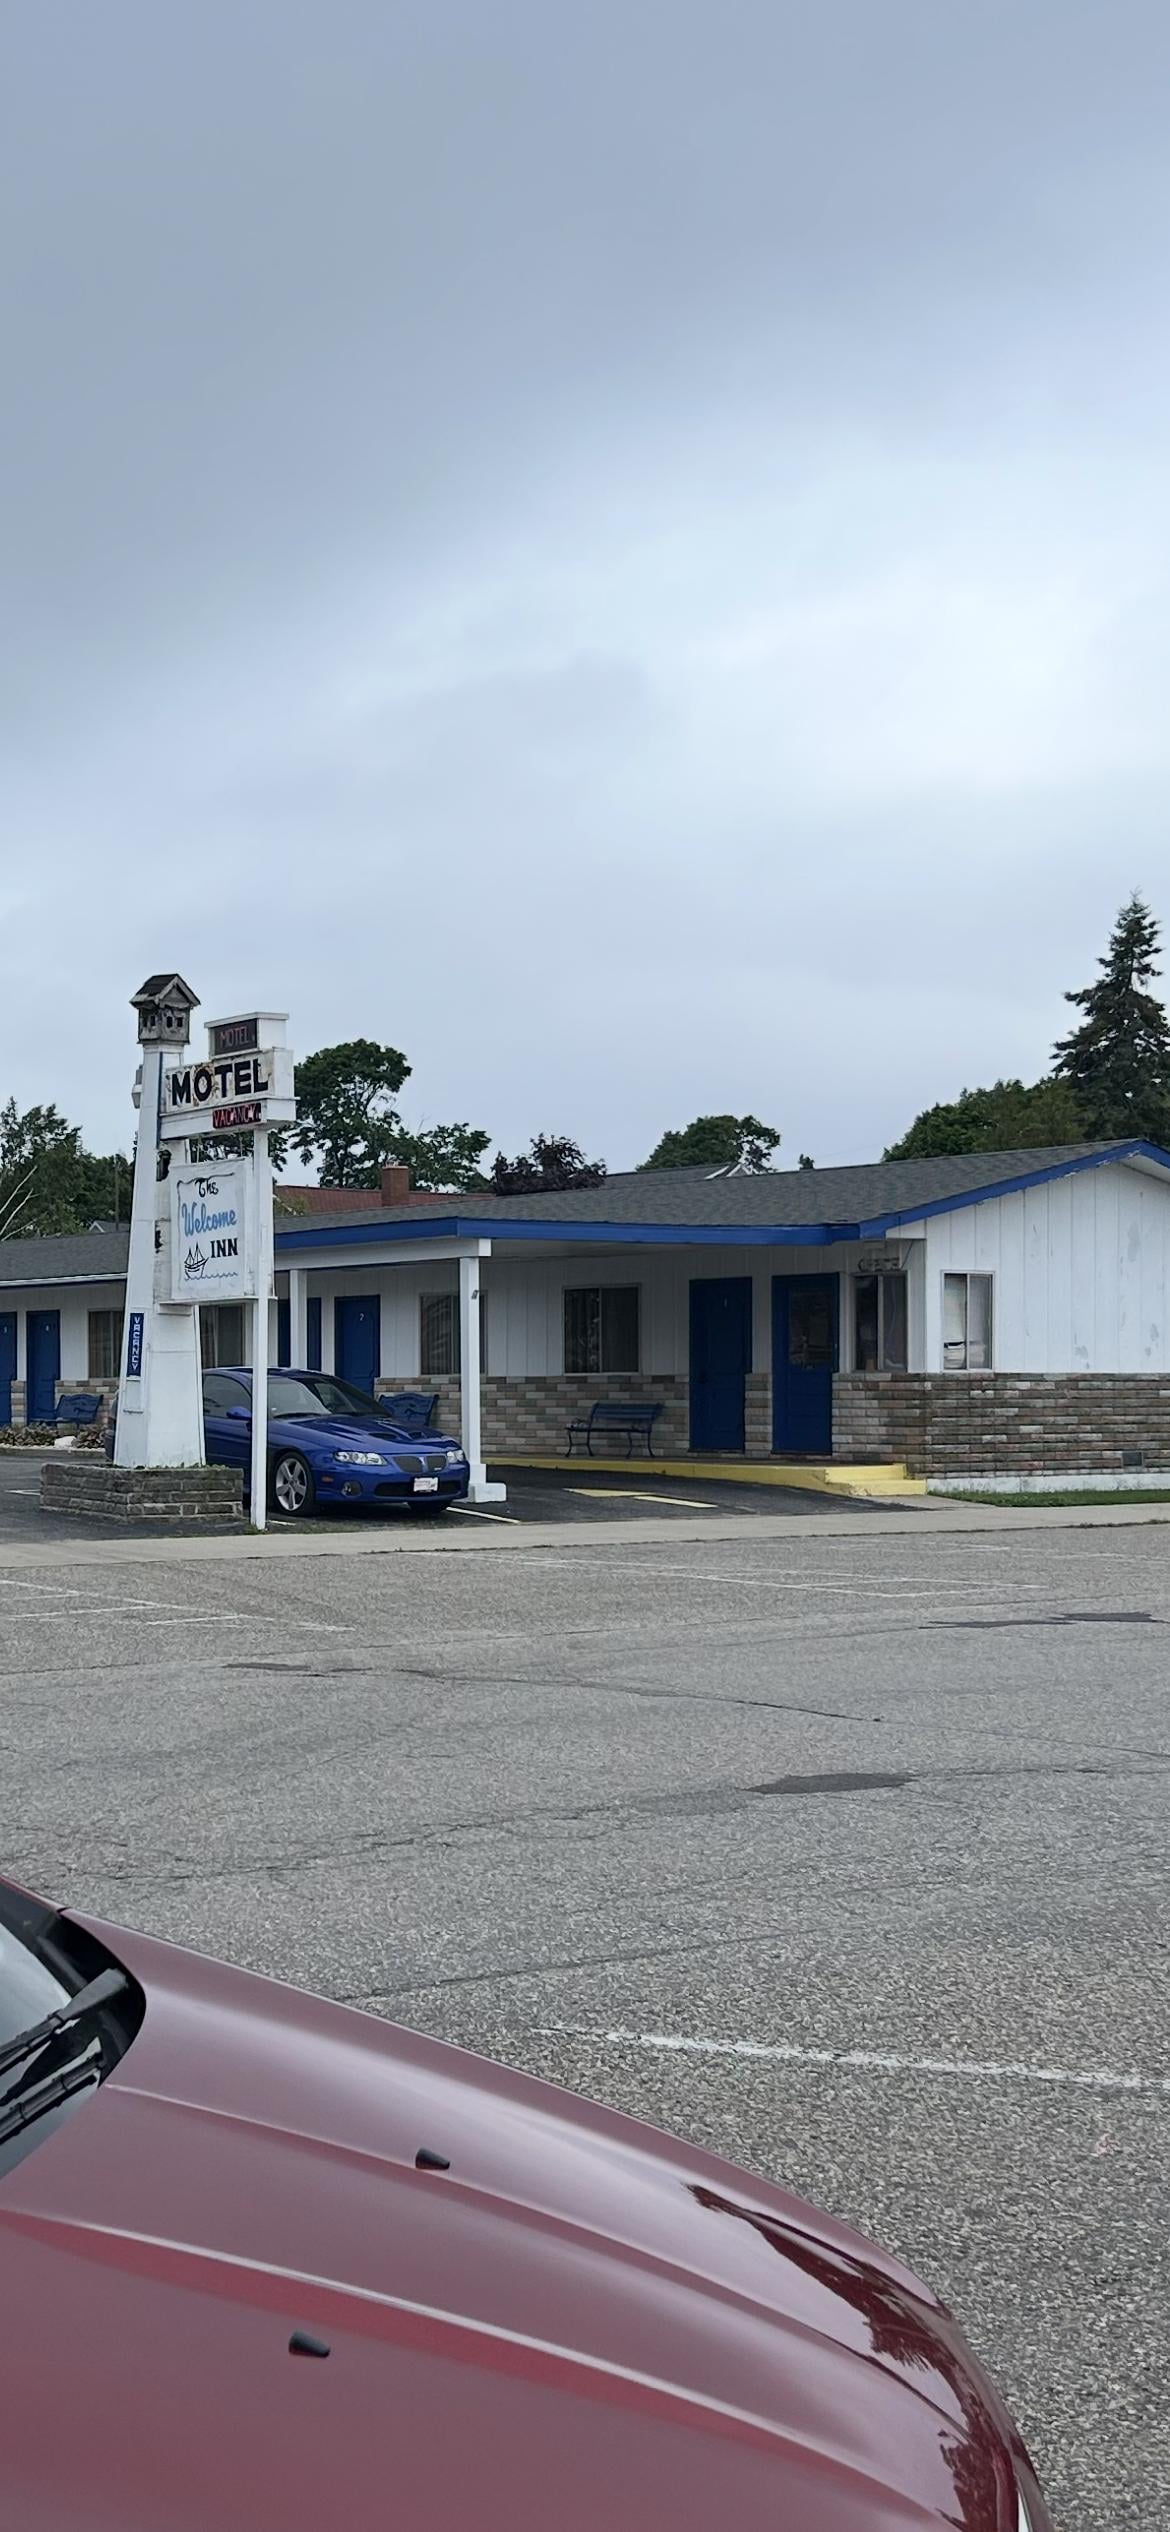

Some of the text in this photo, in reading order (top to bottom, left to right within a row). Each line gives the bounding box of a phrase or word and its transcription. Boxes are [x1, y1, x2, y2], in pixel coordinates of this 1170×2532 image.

[219, 1025, 249, 1048] MOTEL
[171, 1058, 269, 1106] MOTEL
[213, 1103, 257, 1127] VACANCY
[194, 1177, 219, 1198] The
[181, 1201, 238, 1237] Welcome
[210, 1238, 239, 1259] INN
[131, 1316, 141, 1372] VACANCY
